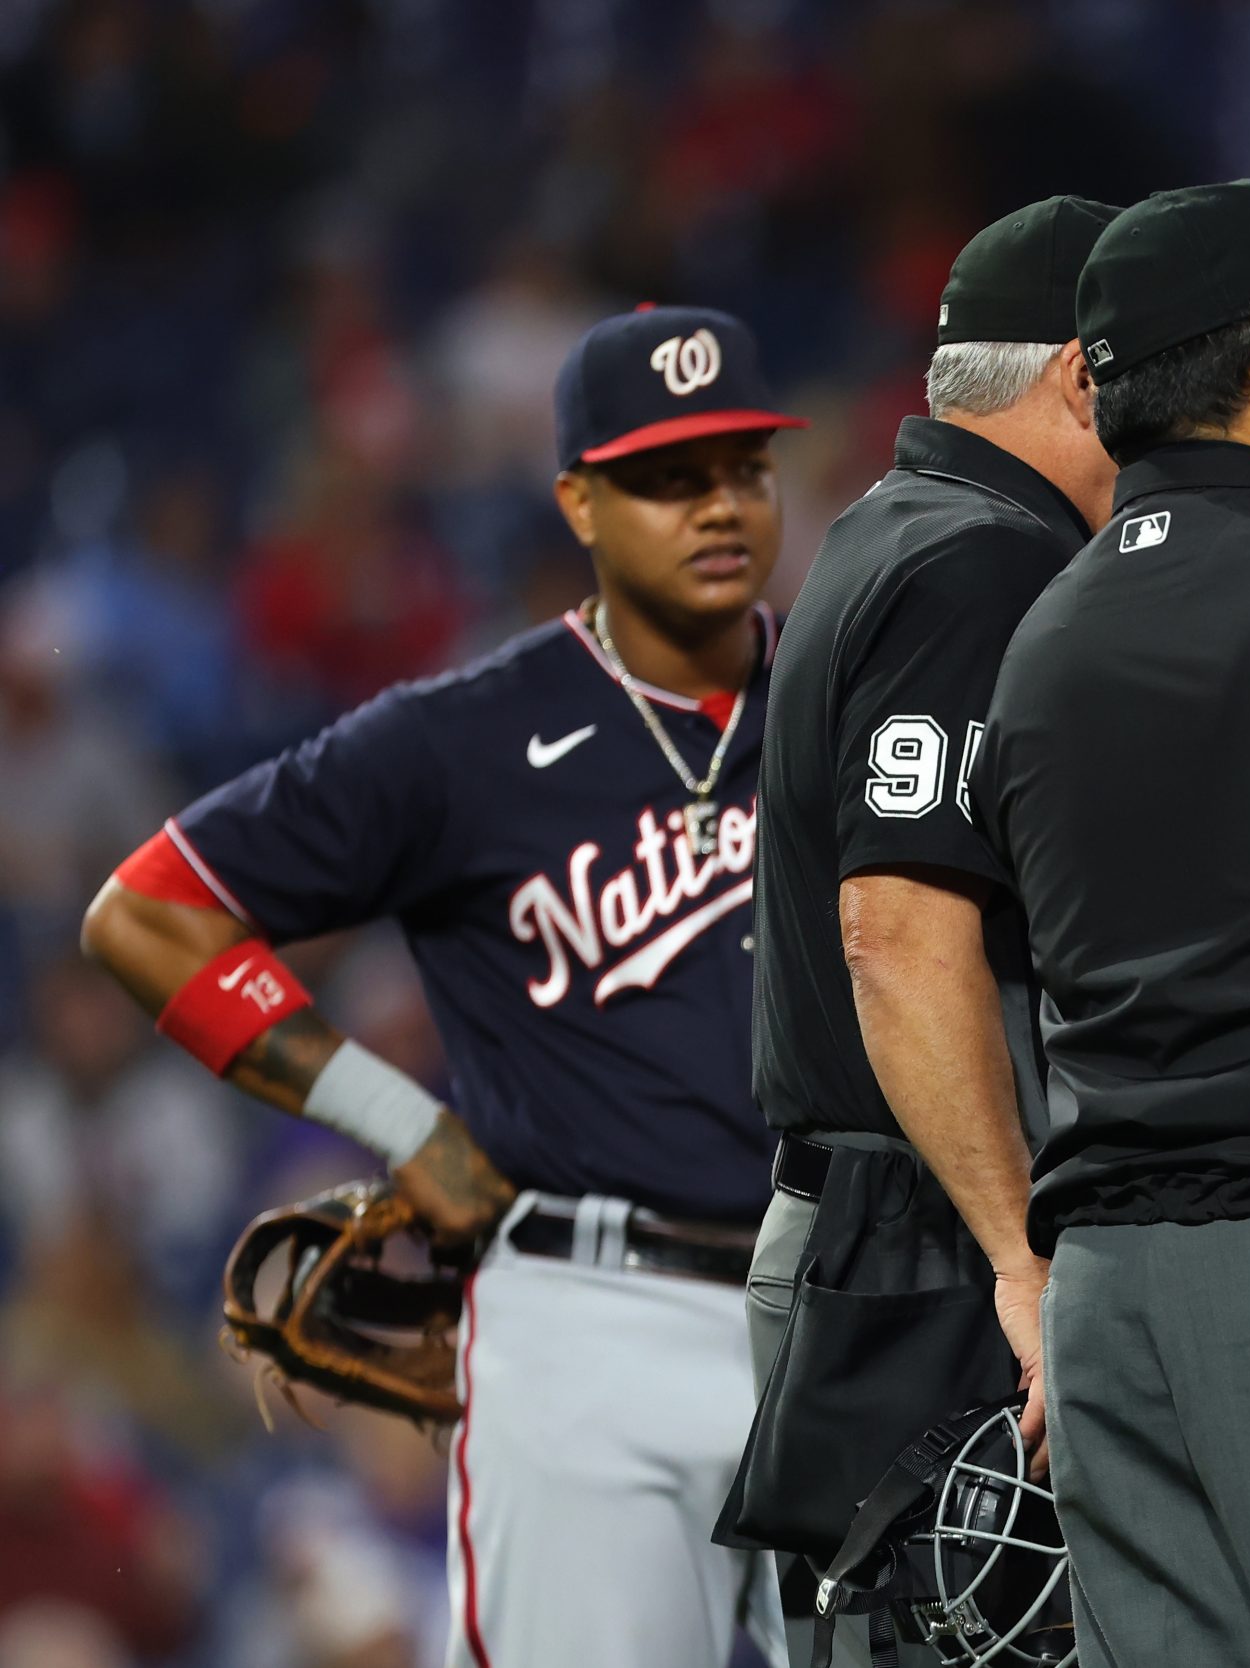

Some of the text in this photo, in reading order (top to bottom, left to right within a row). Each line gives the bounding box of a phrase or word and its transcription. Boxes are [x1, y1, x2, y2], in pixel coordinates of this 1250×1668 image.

[650, 328, 722, 396] W
[865, 714, 986, 826] 9
[241, 970, 286, 1015] 13
